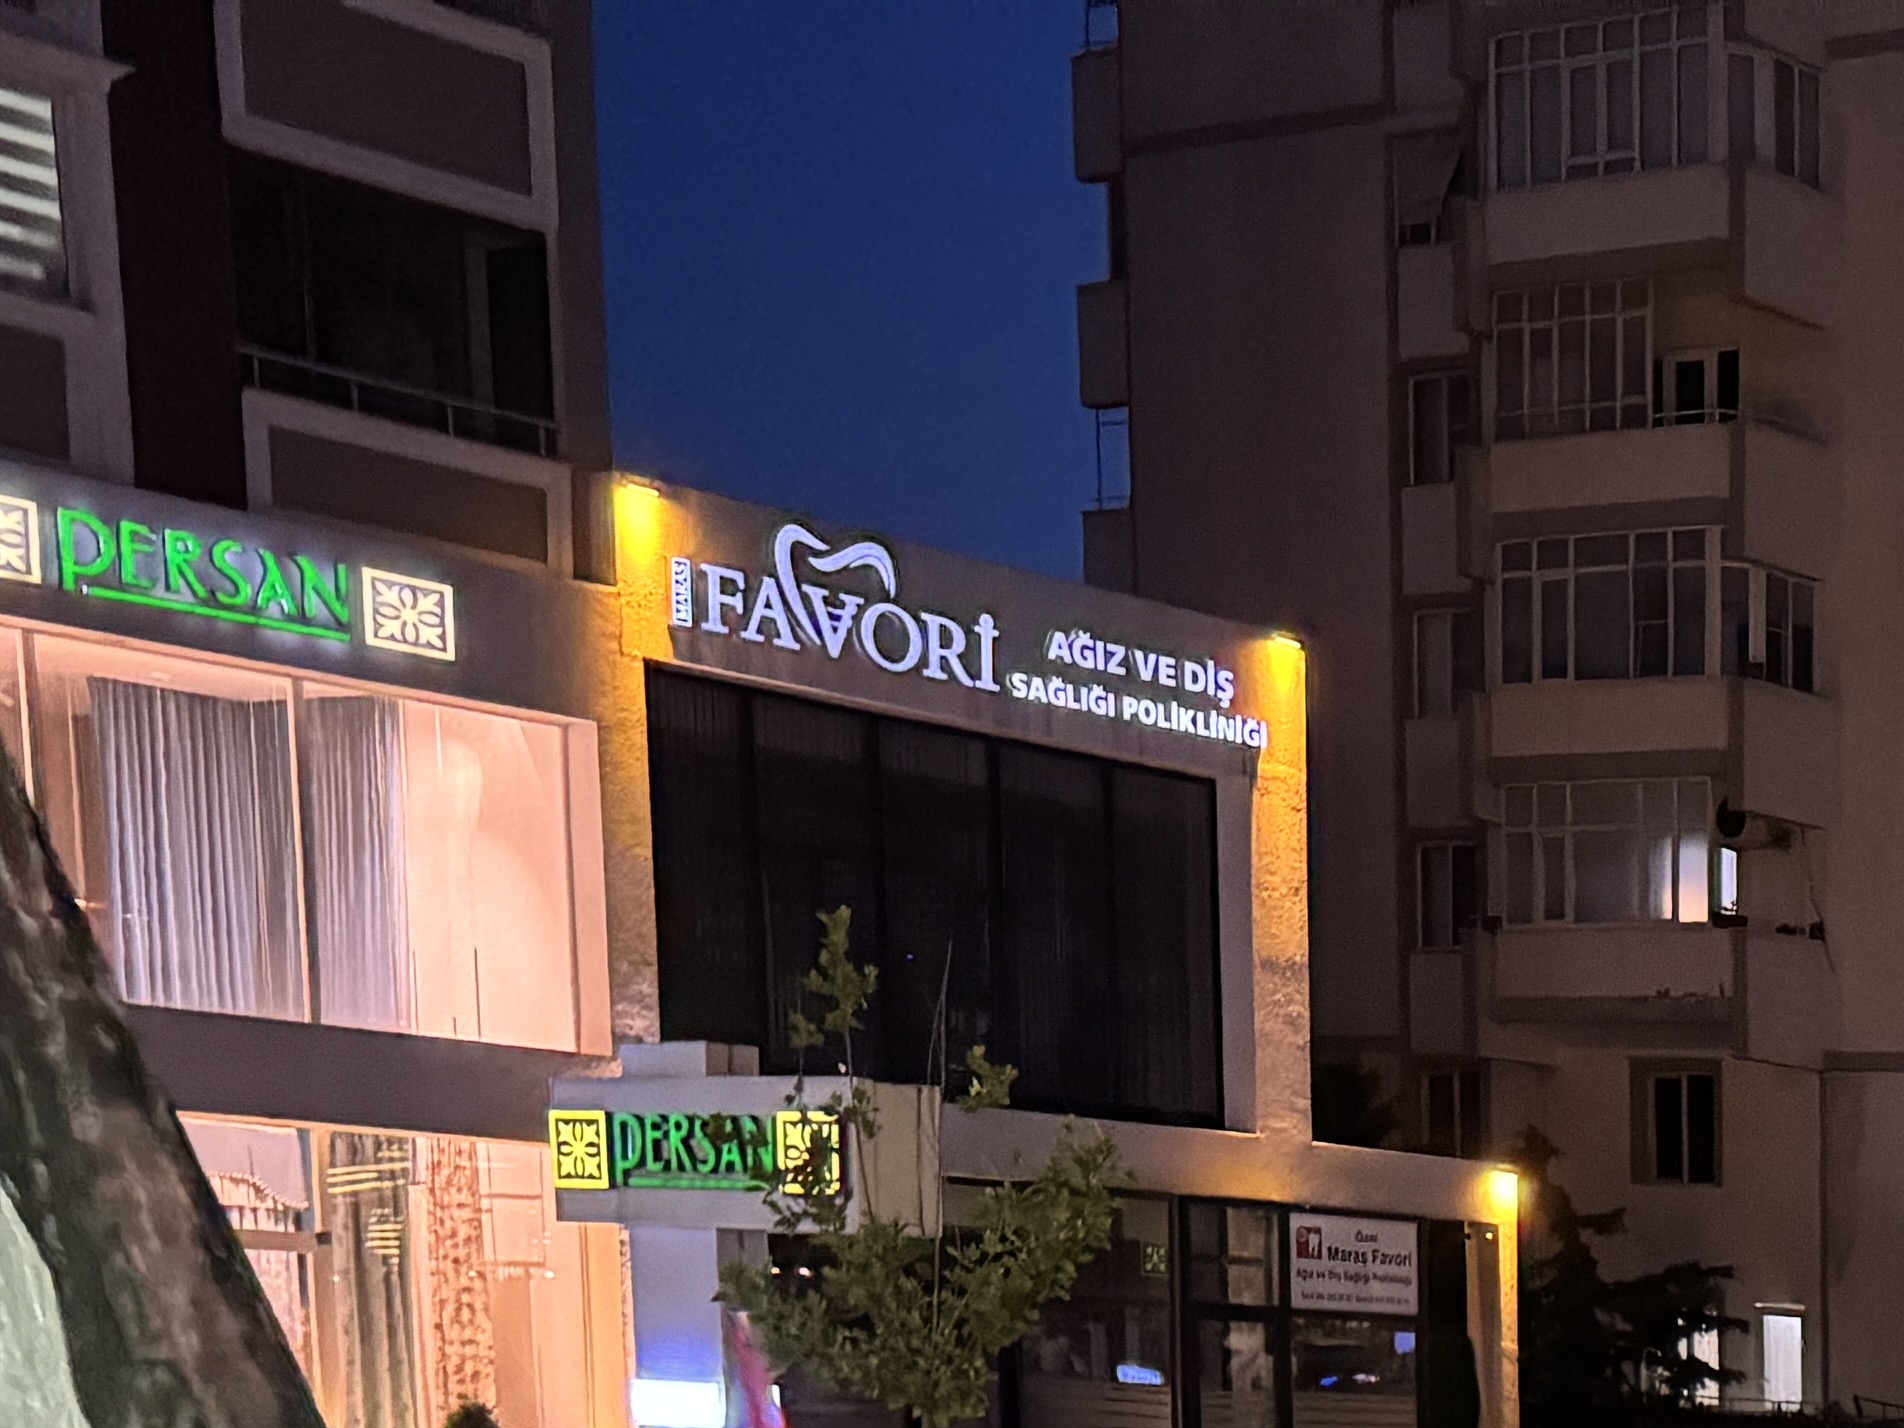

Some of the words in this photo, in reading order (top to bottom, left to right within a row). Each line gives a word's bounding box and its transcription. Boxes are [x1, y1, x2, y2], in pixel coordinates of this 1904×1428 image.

[57, 507, 351, 625] PERSAN
[700, 562, 1000, 692] FAVORİ
[1048, 631, 1126, 676] AĞIZ
[1134, 649, 1176, 687] VE
[1184, 660, 1234, 708] DİŞ
[1010, 672, 1115, 717] SAĞLIĞI
[1122, 696, 1267, 748] POLİKLİNİĞİ
[611, 1112, 774, 1186] PERSAN
